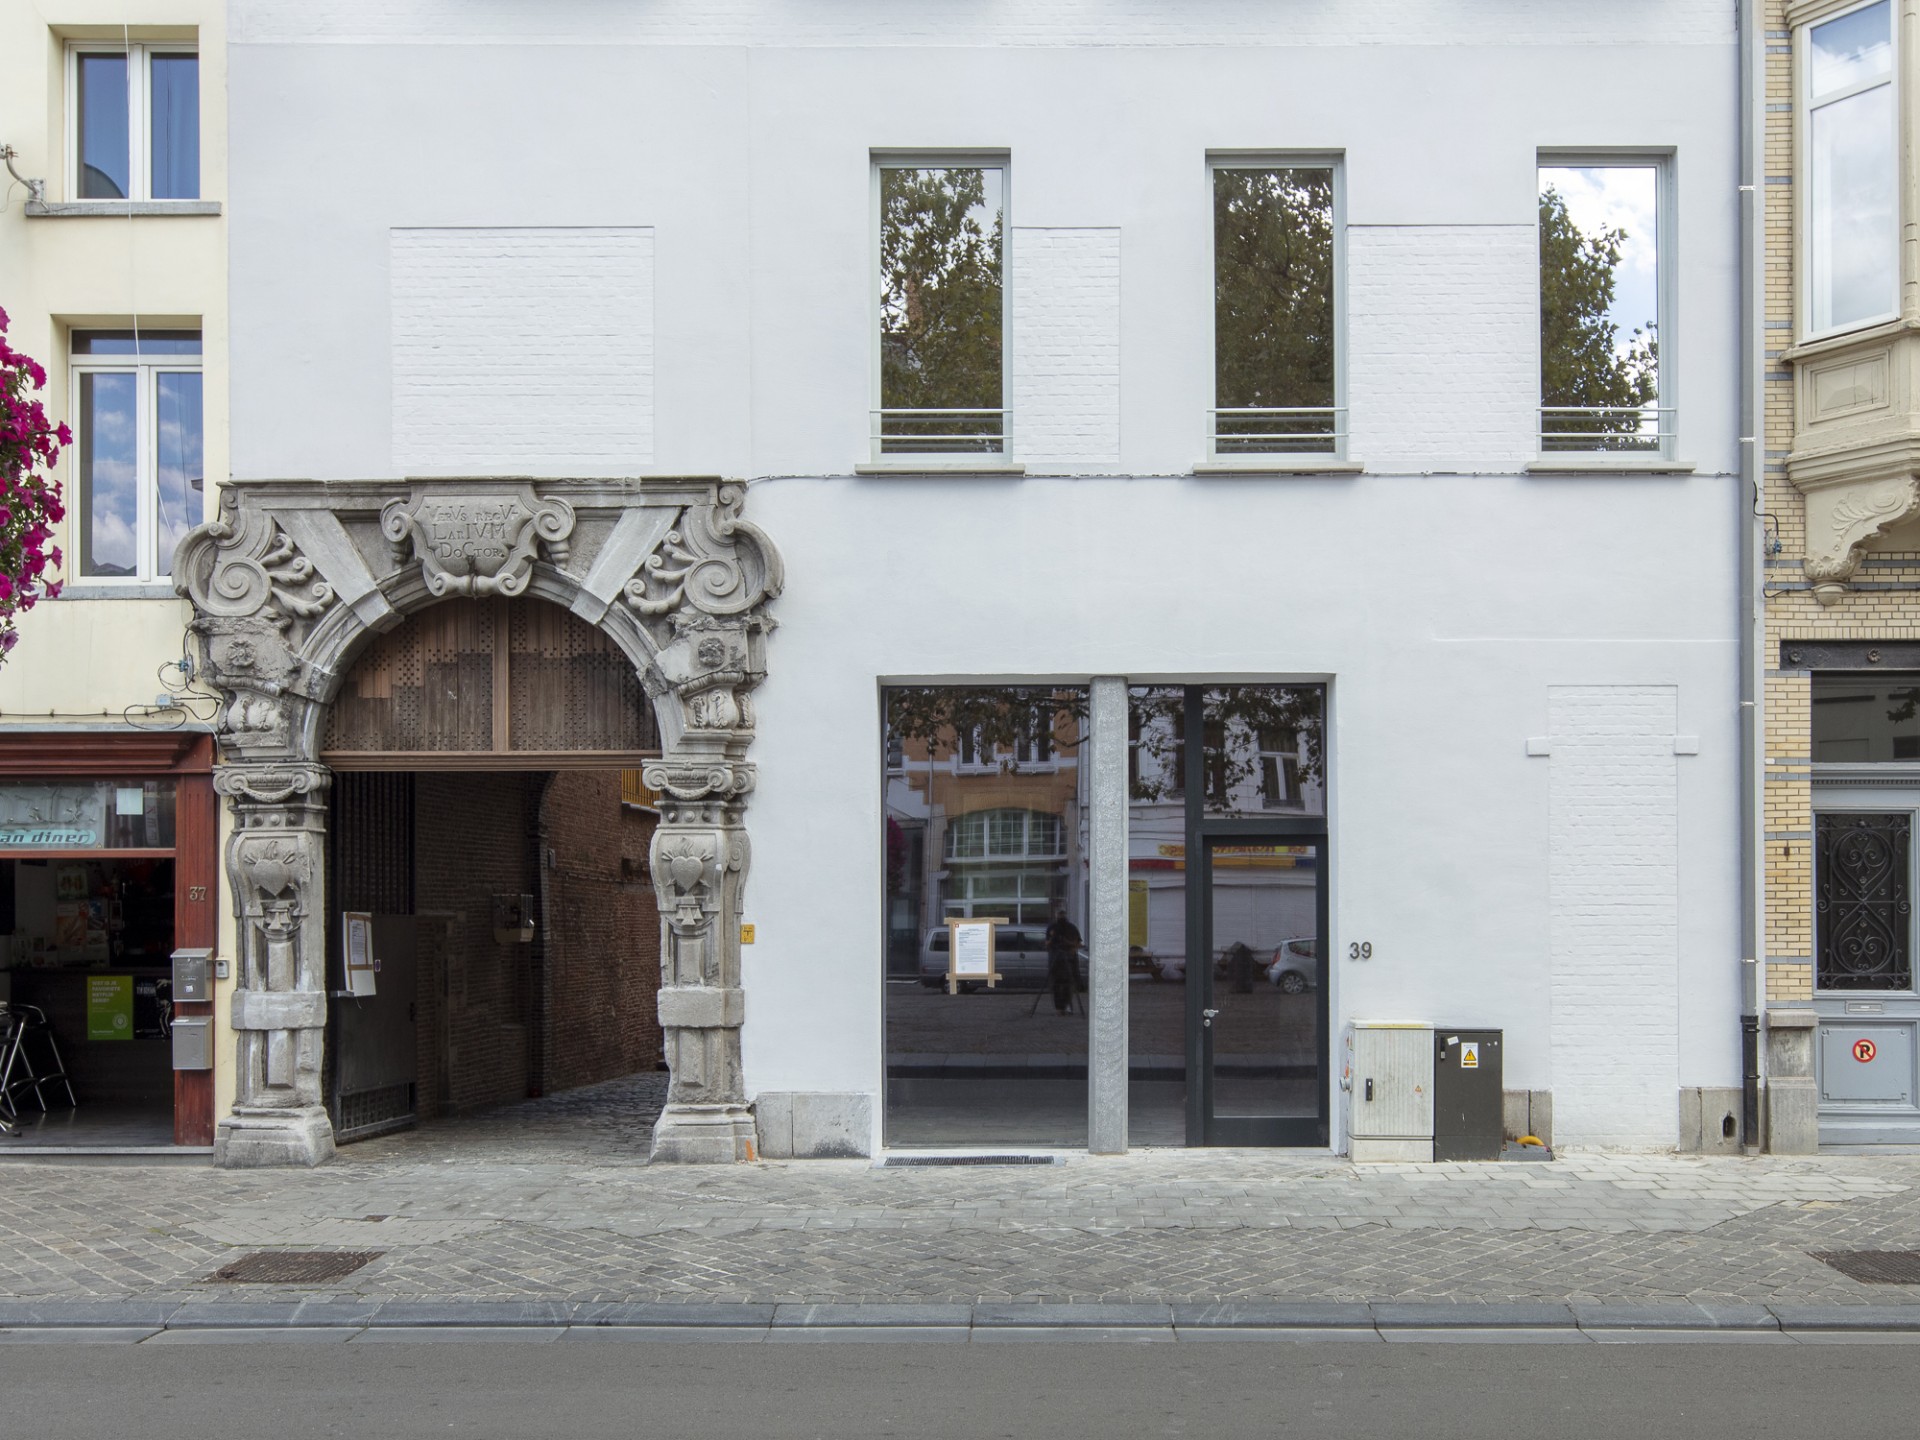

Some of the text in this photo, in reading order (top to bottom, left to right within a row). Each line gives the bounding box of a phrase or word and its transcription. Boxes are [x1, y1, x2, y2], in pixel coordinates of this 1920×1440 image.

[32, 832, 89, 843] diner
[189, 886, 207, 900] 37
[1350, 941, 1372, 960] 39
